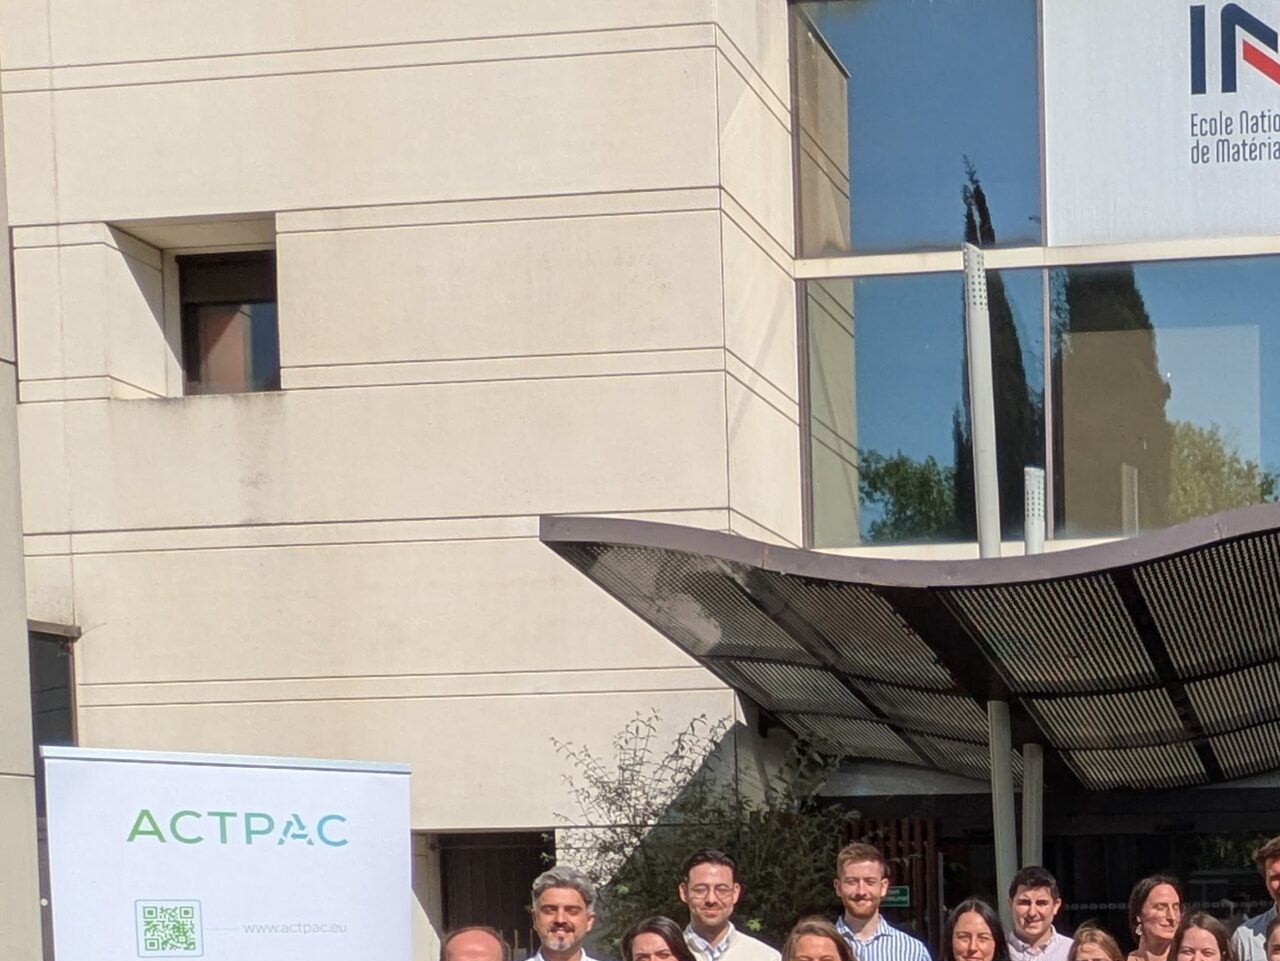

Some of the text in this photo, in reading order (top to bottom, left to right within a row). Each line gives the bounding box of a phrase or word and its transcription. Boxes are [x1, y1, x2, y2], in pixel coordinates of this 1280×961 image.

[1190, 111, 1234, 137] Ecole
[1190, 138, 1210, 164] de
[127, 808, 349, 847] ACTPAC
[242, 920, 348, 936] www.actpac.eu
